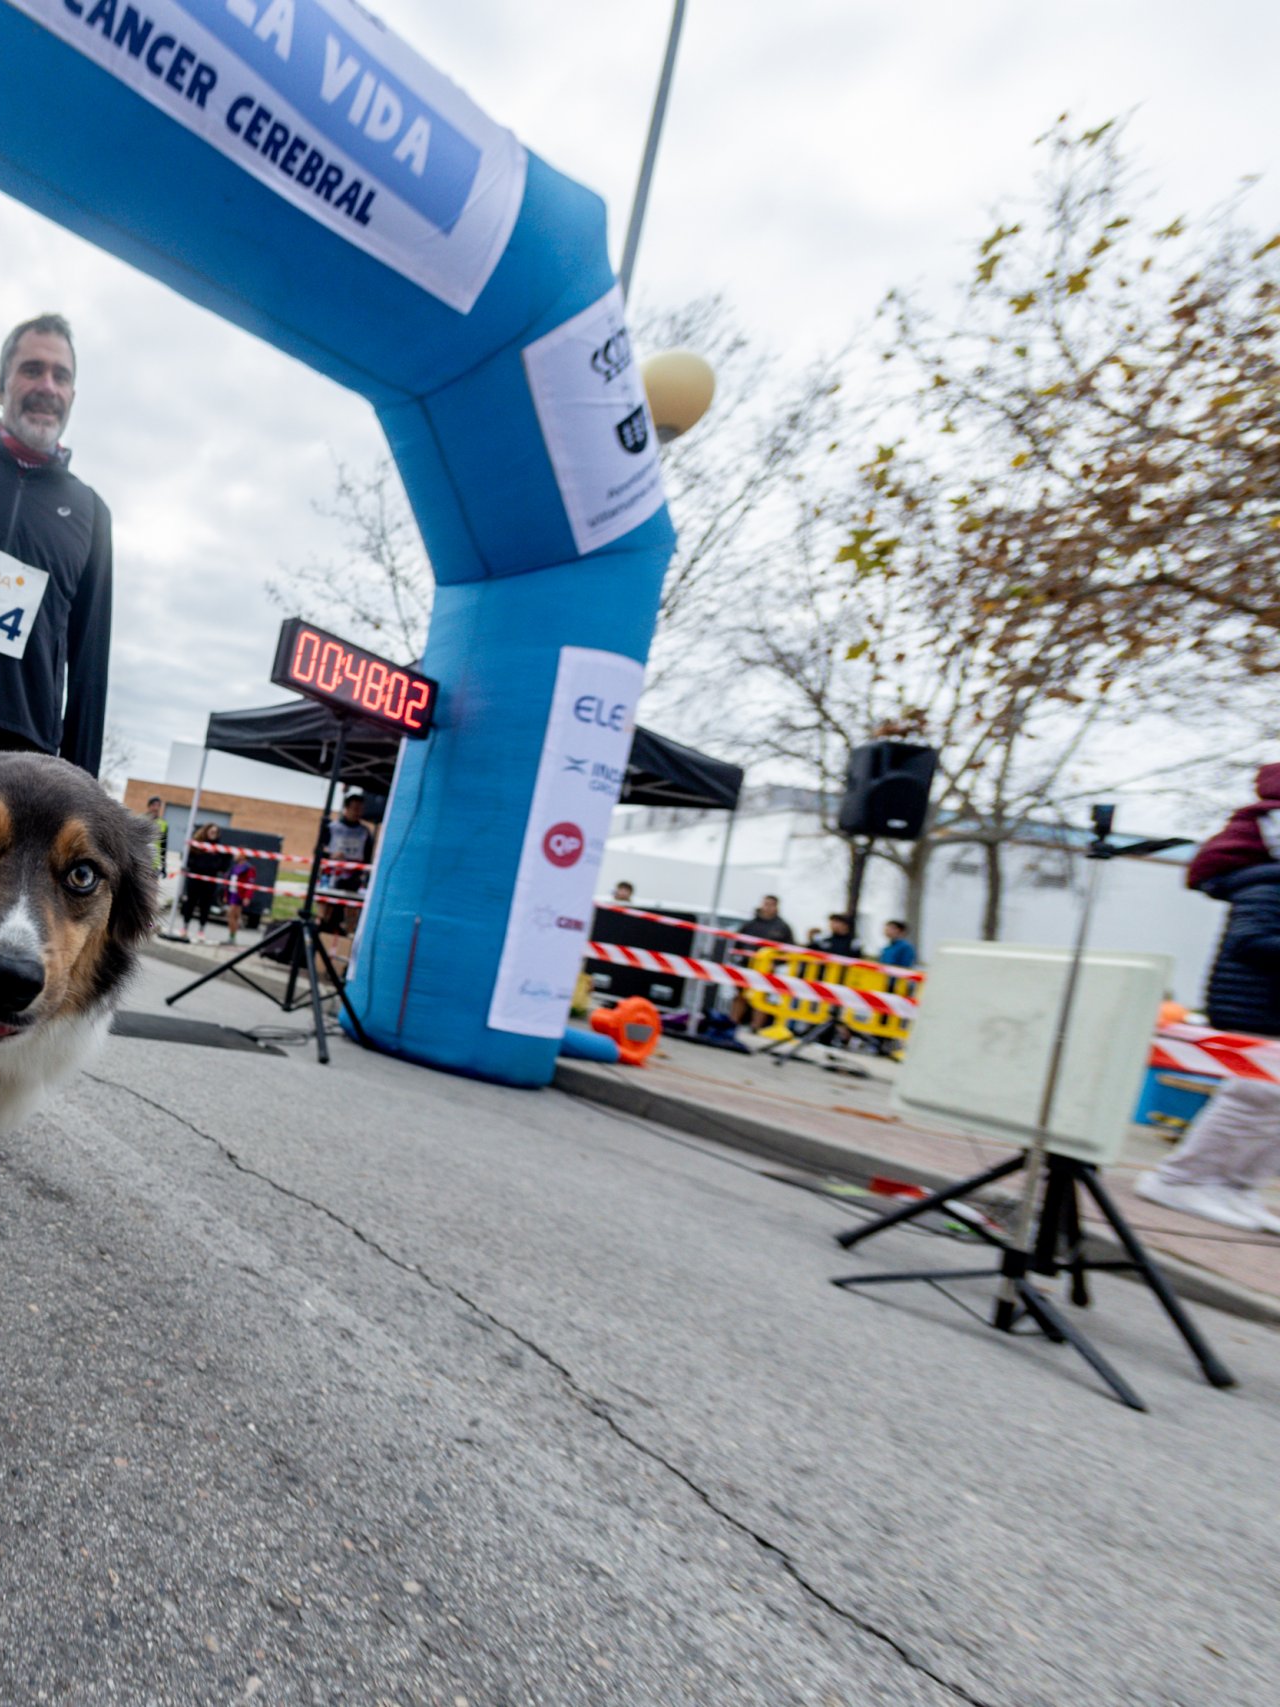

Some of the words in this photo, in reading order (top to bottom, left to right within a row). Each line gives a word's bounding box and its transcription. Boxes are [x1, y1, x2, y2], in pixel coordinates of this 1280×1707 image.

[225, 95, 376, 227] CEREBRAL
[320, 33, 431, 177] VIDA
[290, 630, 431, 729] 00:48:02
